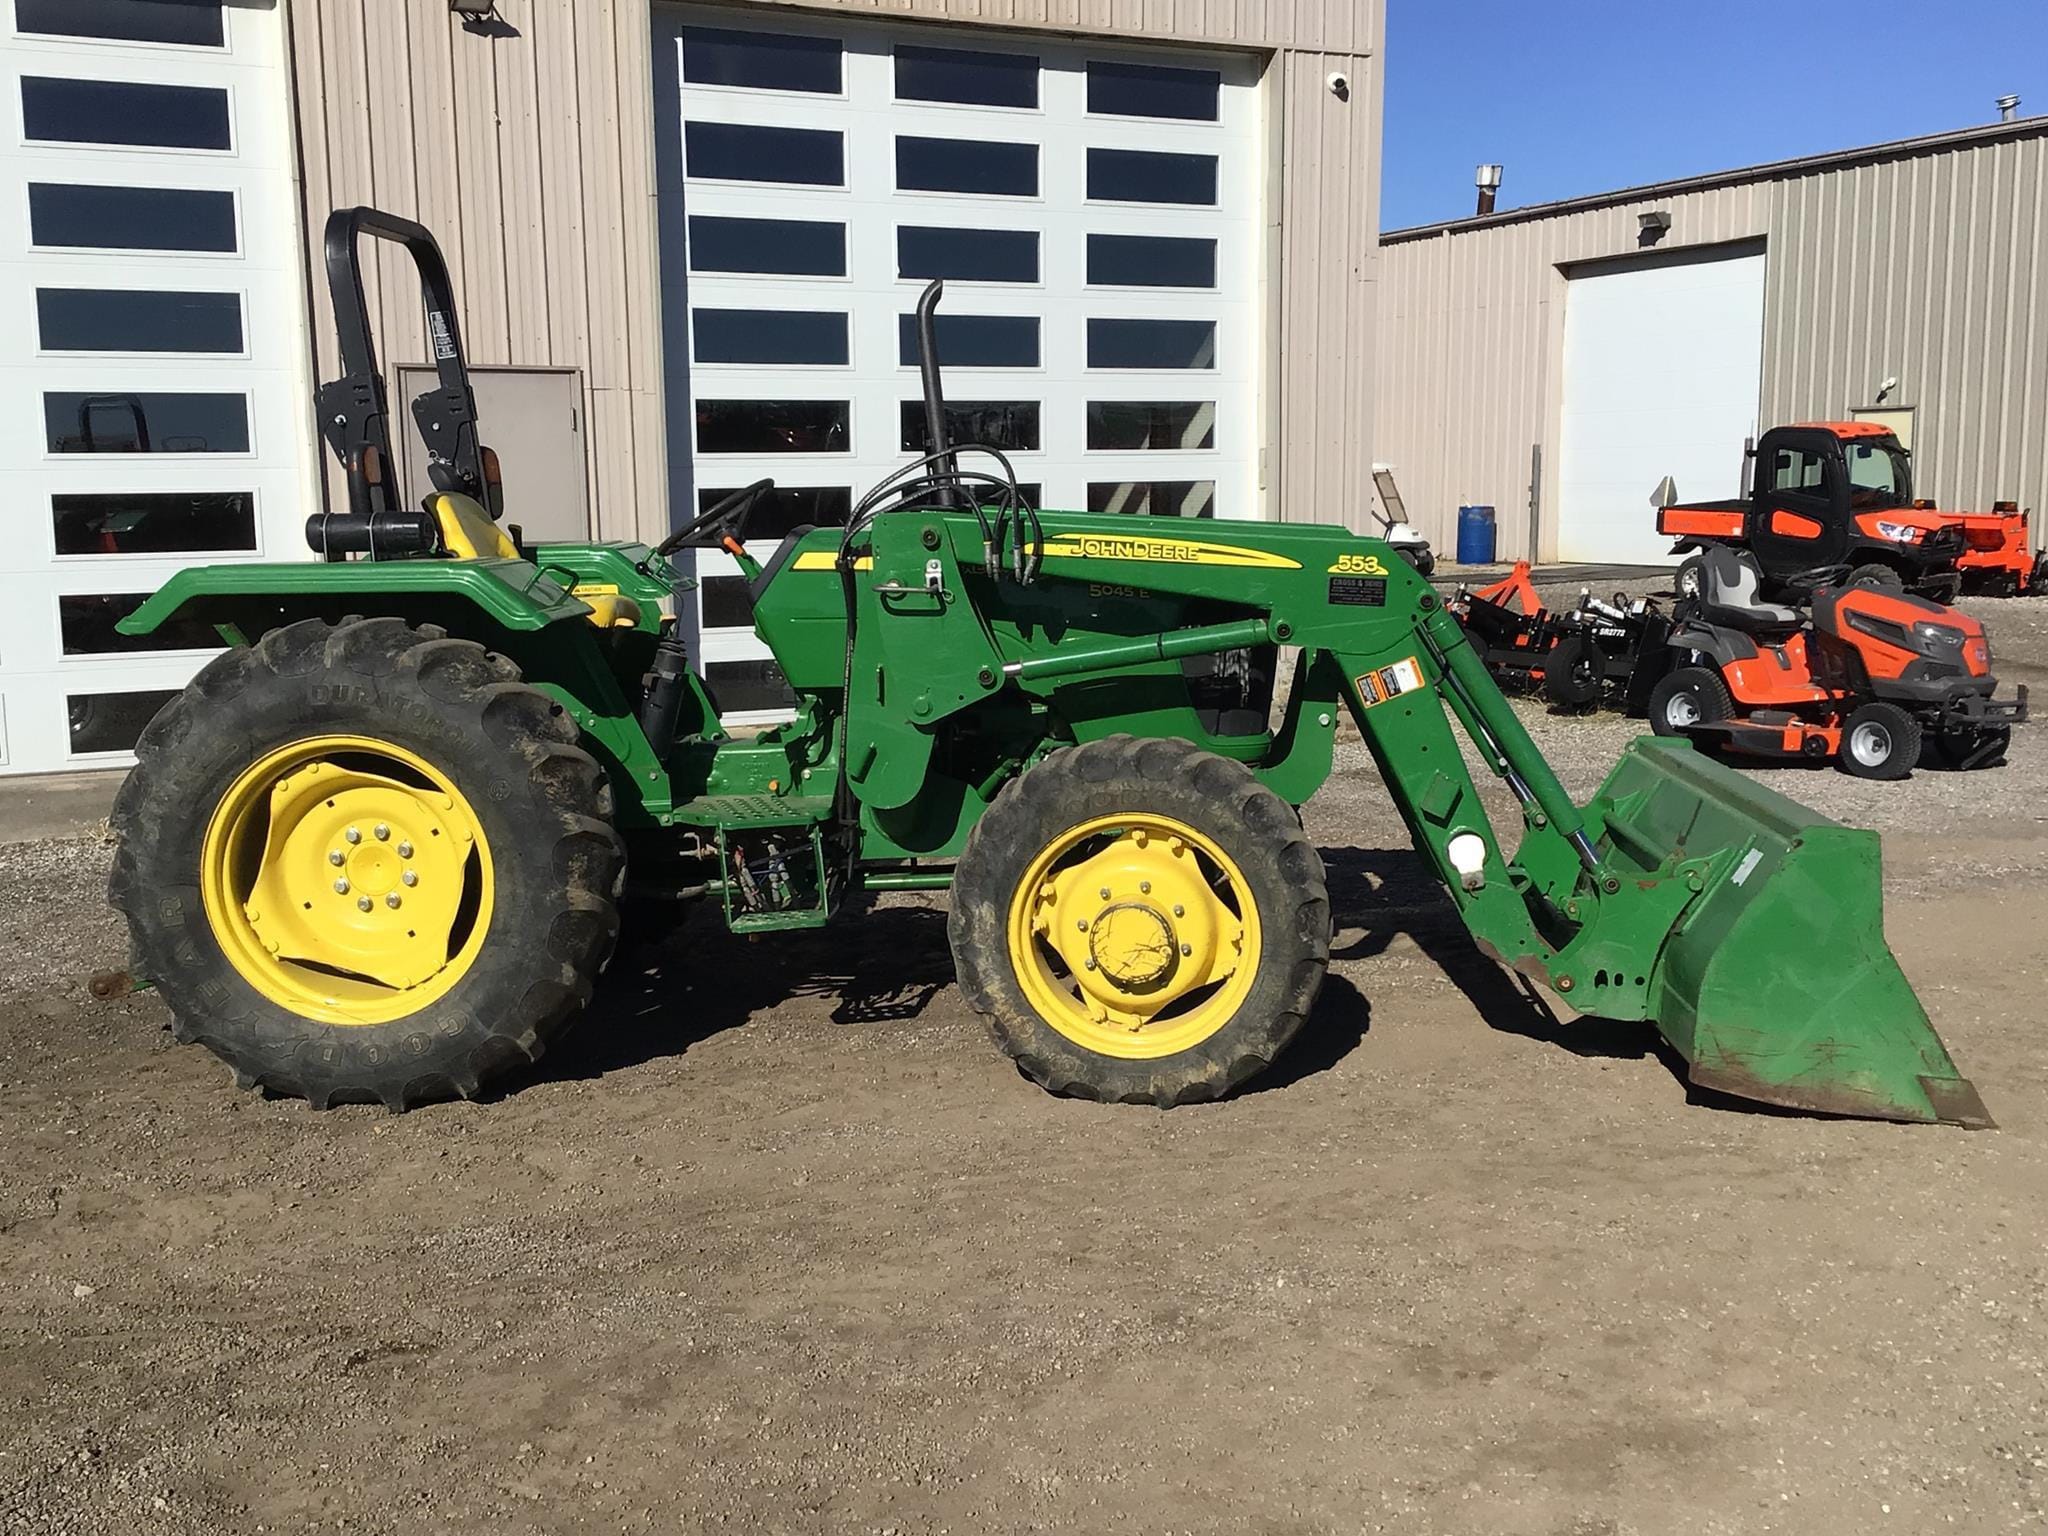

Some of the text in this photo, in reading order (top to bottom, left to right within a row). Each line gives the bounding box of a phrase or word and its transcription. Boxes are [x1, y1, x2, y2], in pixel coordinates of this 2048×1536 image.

[1071, 537, 1199, 560] JOHN DEERE
[1338, 554, 1378, 572] 553
[1088, 583, 1151, 599] 5045 E
